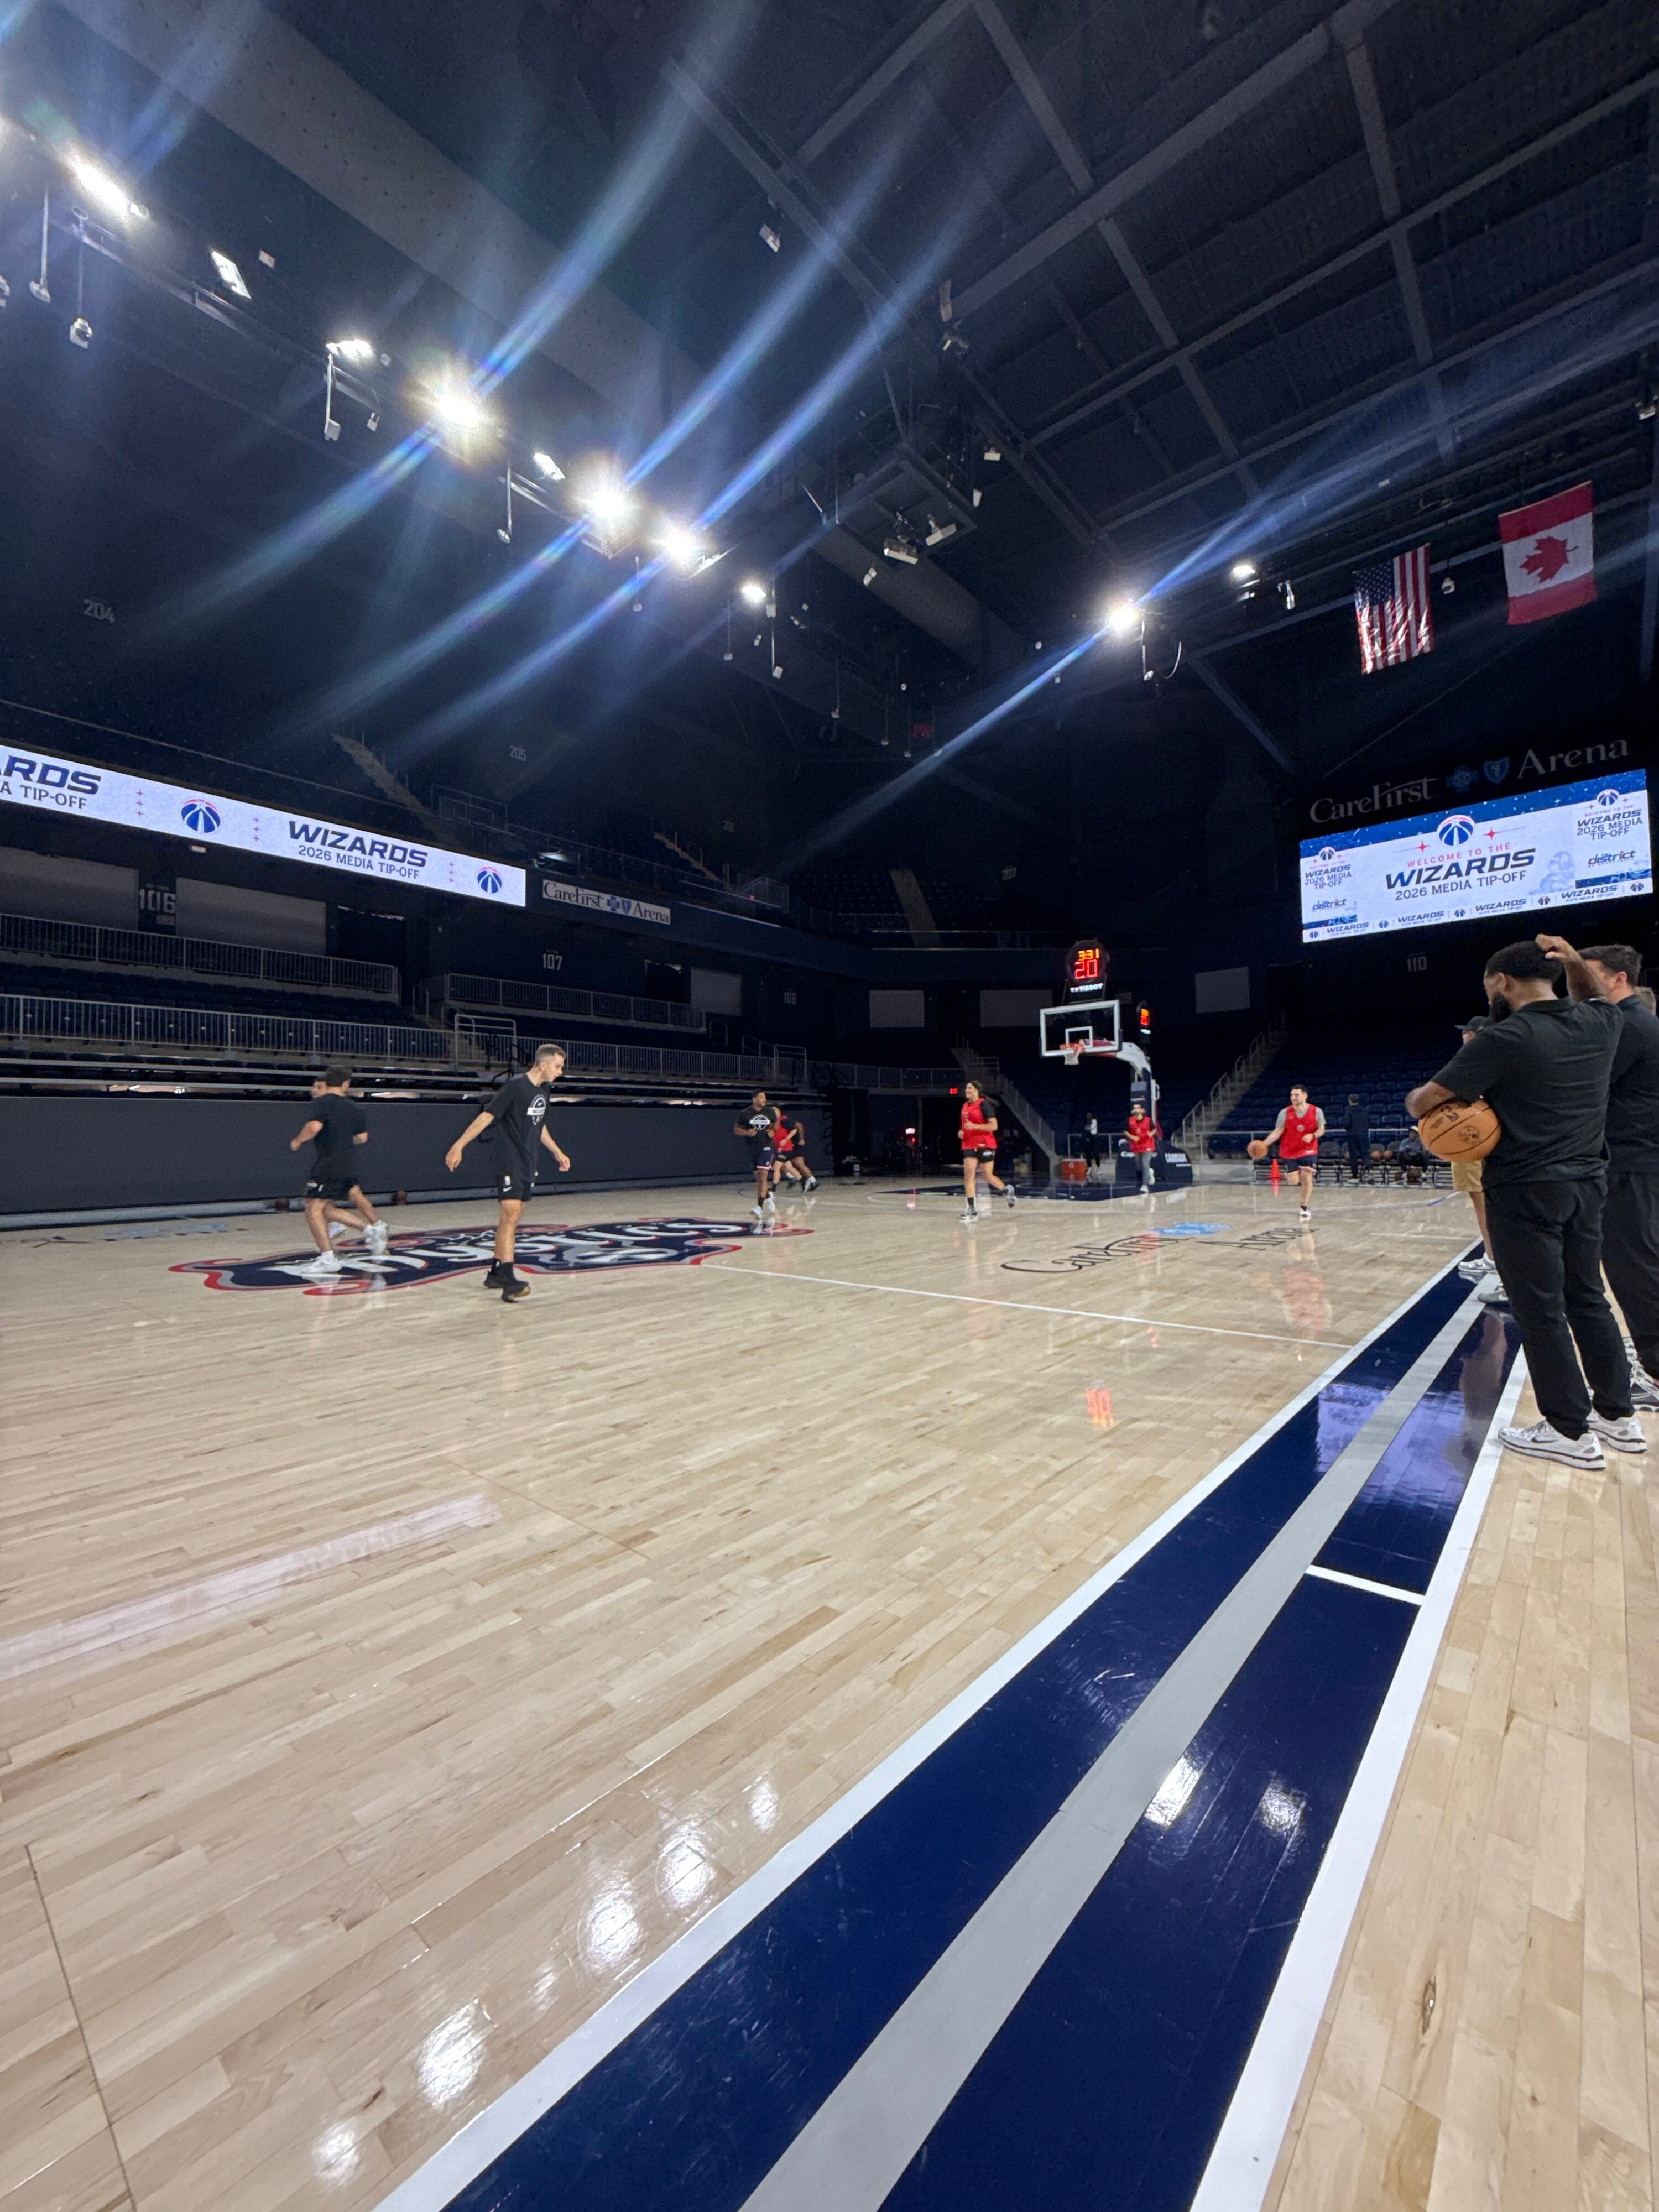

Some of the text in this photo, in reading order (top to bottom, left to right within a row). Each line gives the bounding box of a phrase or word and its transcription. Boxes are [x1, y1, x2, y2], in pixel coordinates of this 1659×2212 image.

[0, 755, 101, 795] RDS
[1310, 739, 1629, 824] CareFirst Arena
[20, 785, 87, 809] TIP-OFF
[1577, 809, 1642, 827] WIZARDS
[1577, 817, 1642, 836] 2026 MEDIA
[1590, 827, 1629, 841] TIP-OFF
[289, 820, 428, 867] WIZARDS
[298, 845, 419, 879] 2026 MEDIA TIP-OFF
[1407, 843, 1511, 868] WELCOME TO THE
[1588, 850, 1636, 865] district
[1305, 864, 1351, 878] WIZARDS
[1386, 848, 1536, 889] WIZARDS
[1305, 871, 1352, 885] 2026 MEDIA
[1314, 879, 1342, 890] TIP-OFF
[1395, 870, 1526, 901] 2026 MEDIA TIP-OFF
[1561, 885, 1618, 899] WIZARDS
[139, 889, 176, 914] 106
[544, 881, 669, 923] CareFirst Arena
[1475, 898, 1526, 912] WIZARDS
[1397, 910, 1444, 923] WIZARDS
[1327, 922, 1369, 933] WIZARDS
[542, 953, 562, 971] 107
[1074, 959, 1098, 979] 20
[1407, 956, 1427, 972] 110
